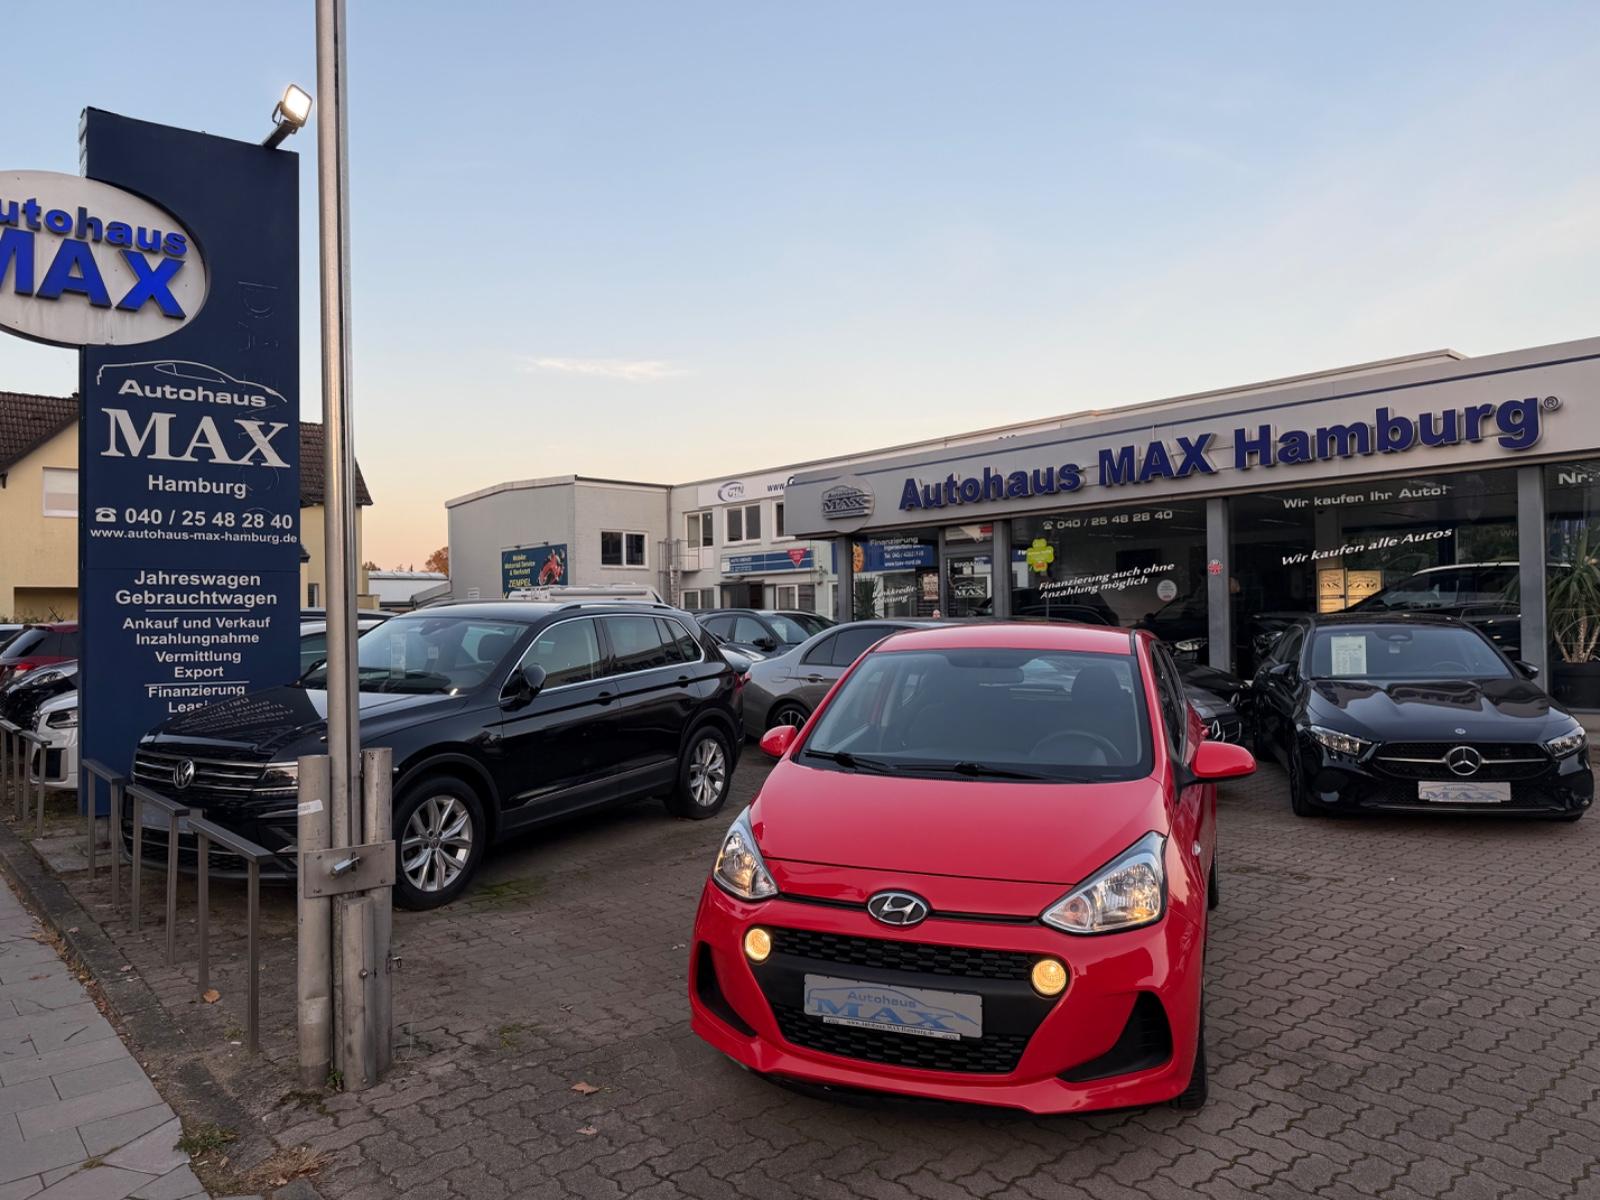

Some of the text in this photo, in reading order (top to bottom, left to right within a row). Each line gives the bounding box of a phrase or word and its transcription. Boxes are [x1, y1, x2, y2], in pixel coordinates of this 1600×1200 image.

[0, 198, 188, 258] utohaus
[118, 379, 266, 407] Autohaus
[100, 407, 291, 468] MAX
[898, 463, 1085, 512] Autohaus
[1097, 433, 1217, 487] MAX
[148, 474, 247, 499] Hamburg
[823, 497, 864, 513] MAX
[1283, 485, 1448, 510] Wir kaufen Ihr Auto!
[125, 508, 293, 530] 040 / 25 48 28 40
[1057, 510, 1173, 530] 040 / 25 48 28 40
[90, 528, 297, 544] www.autohaus-max-hamburg.de
[870, 536, 919, 546] Finanzierung
[1281, 528, 1453, 567] Wir kaufen alle Autos
[134, 570, 261, 589] Jahreswagen
[1038, 562, 1175, 591] Finanzierung auch ohne
[955, 589, 985, 598] MAX
[1040, 575, 1149, 600] Anzahlung möglich
[115, 589, 277, 608] Gebrauchtwagen
[122, 616, 271, 630] Ankauf und Verkauf
[136, 632, 260, 647] Inzahlungnahme
[155, 650, 242, 664] Vermittlung
[174, 666, 224, 680] Export
[148, 685, 245, 699] Finanzierung
[1423, 791, 1498, 800] MAX
[847, 991, 917, 1008] Autohaus
[814, 999, 955, 1031] MAX
